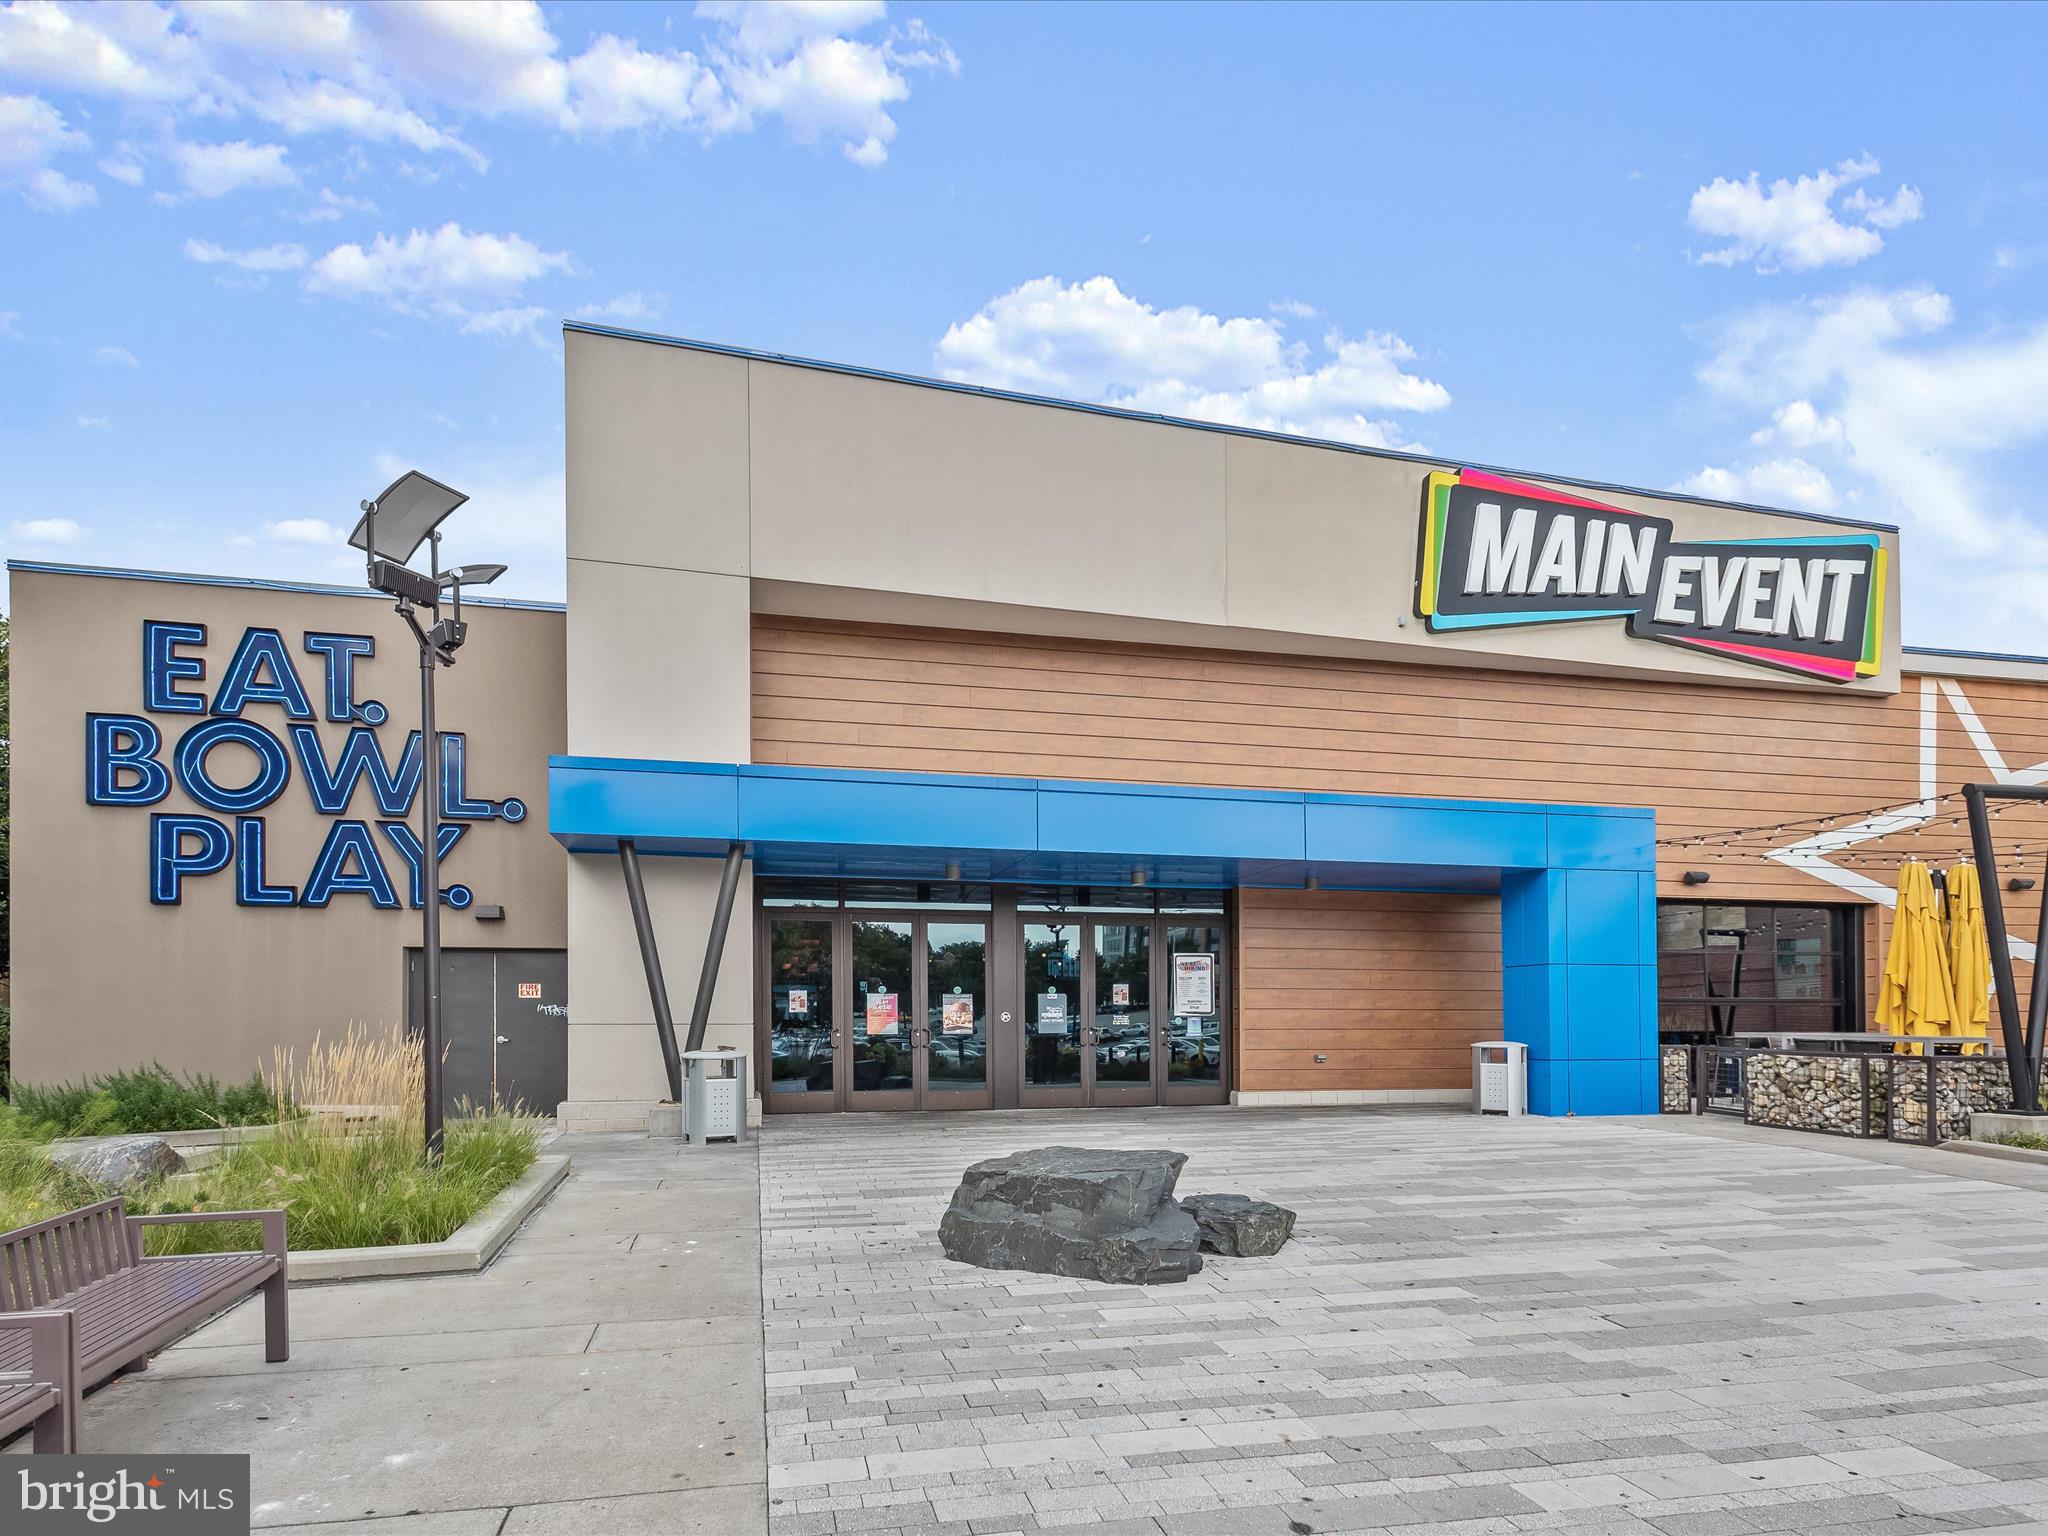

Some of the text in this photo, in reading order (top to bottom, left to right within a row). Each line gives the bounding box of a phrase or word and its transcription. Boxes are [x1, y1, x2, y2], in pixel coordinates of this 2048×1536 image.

[1462, 502, 1866, 643] MAIN EVENT
[143, 619, 389, 726] EAT.
[85, 712, 528, 824] BOWL.
[149, 812, 474, 910] PLAY.
